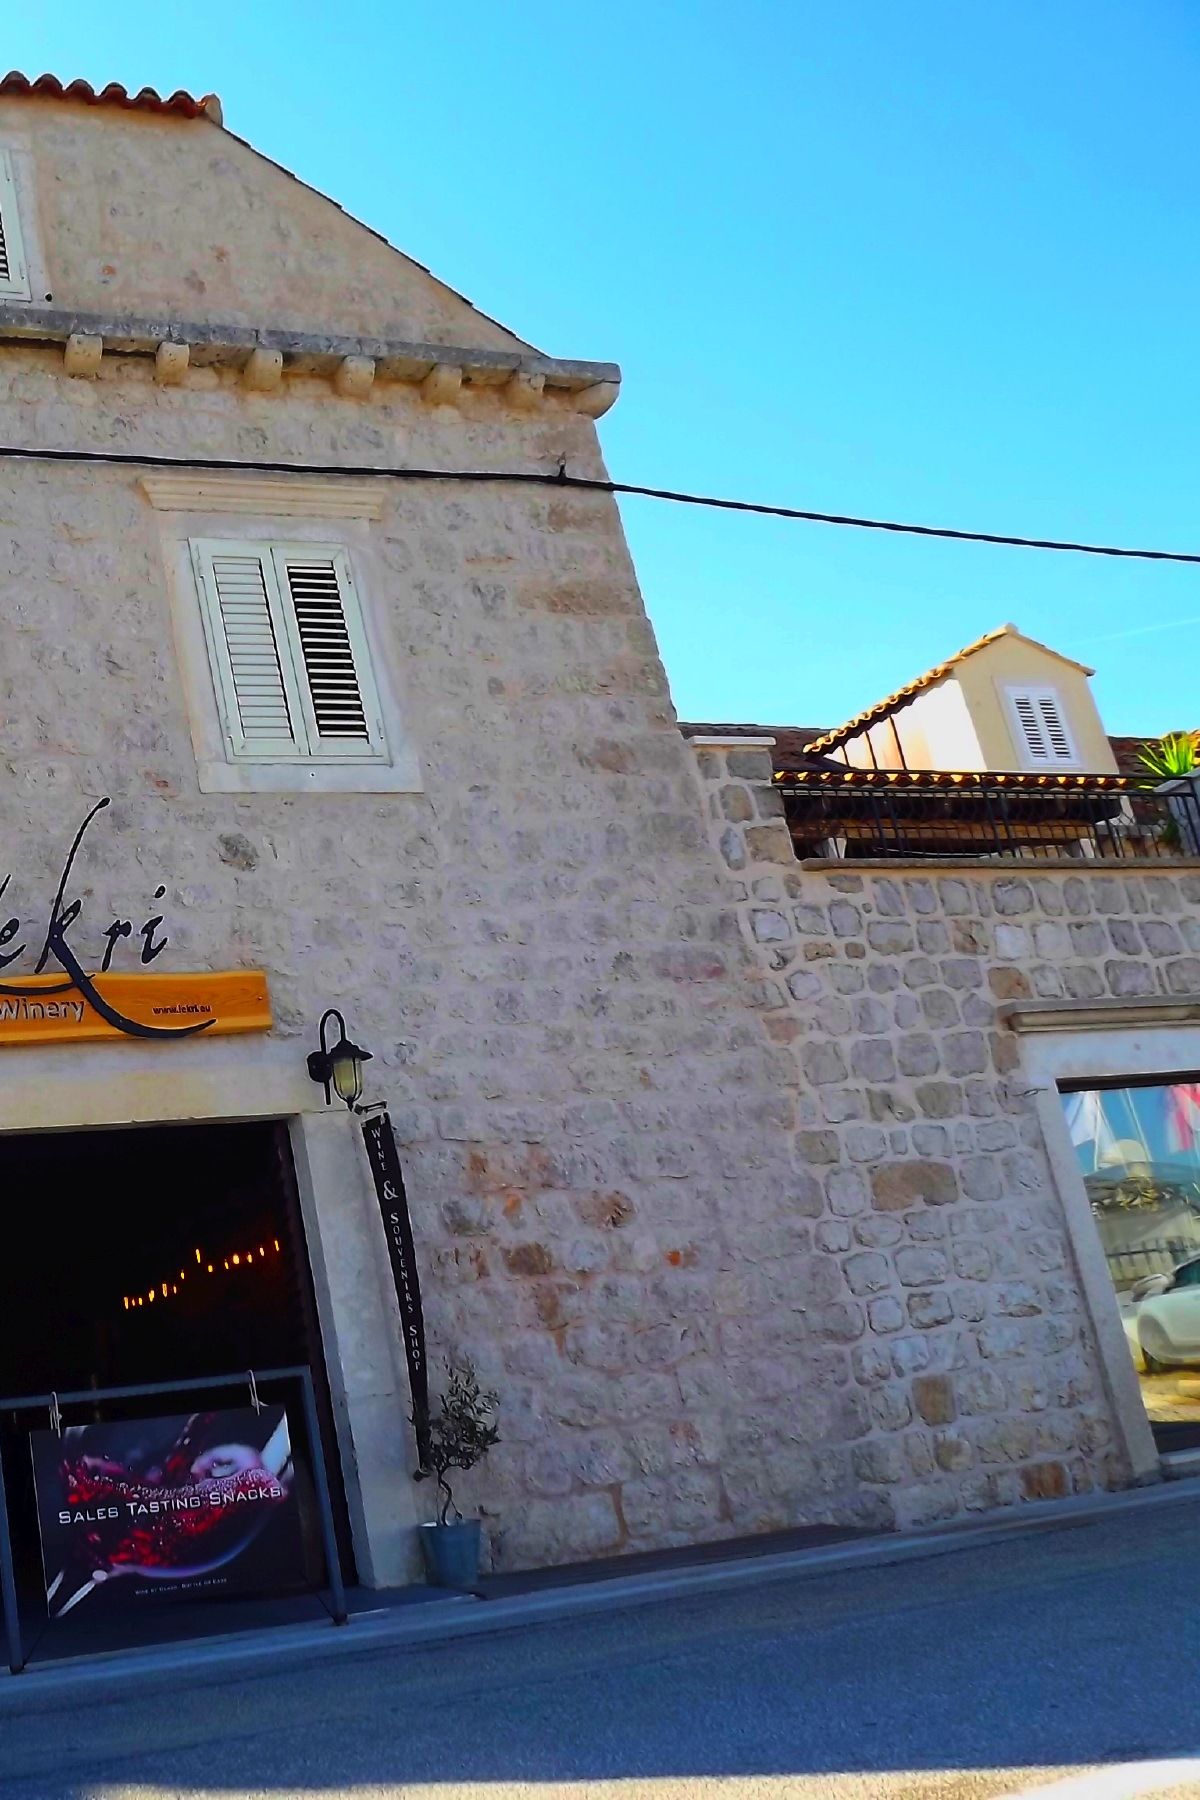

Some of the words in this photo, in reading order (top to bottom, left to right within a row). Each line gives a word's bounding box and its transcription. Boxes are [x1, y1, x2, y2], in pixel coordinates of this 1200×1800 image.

[370, 1128, 387, 1171] WINE
[383, 1180, 399, 1200] &
[390, 1212, 414, 1314] SOUVENIRS
[409, 1324, 421, 1372] SHOP
[58, 1506, 119, 1524] SALES
[126, 1496, 201, 1516] TASTING
[209, 1486, 281, 1506] SNACKS
